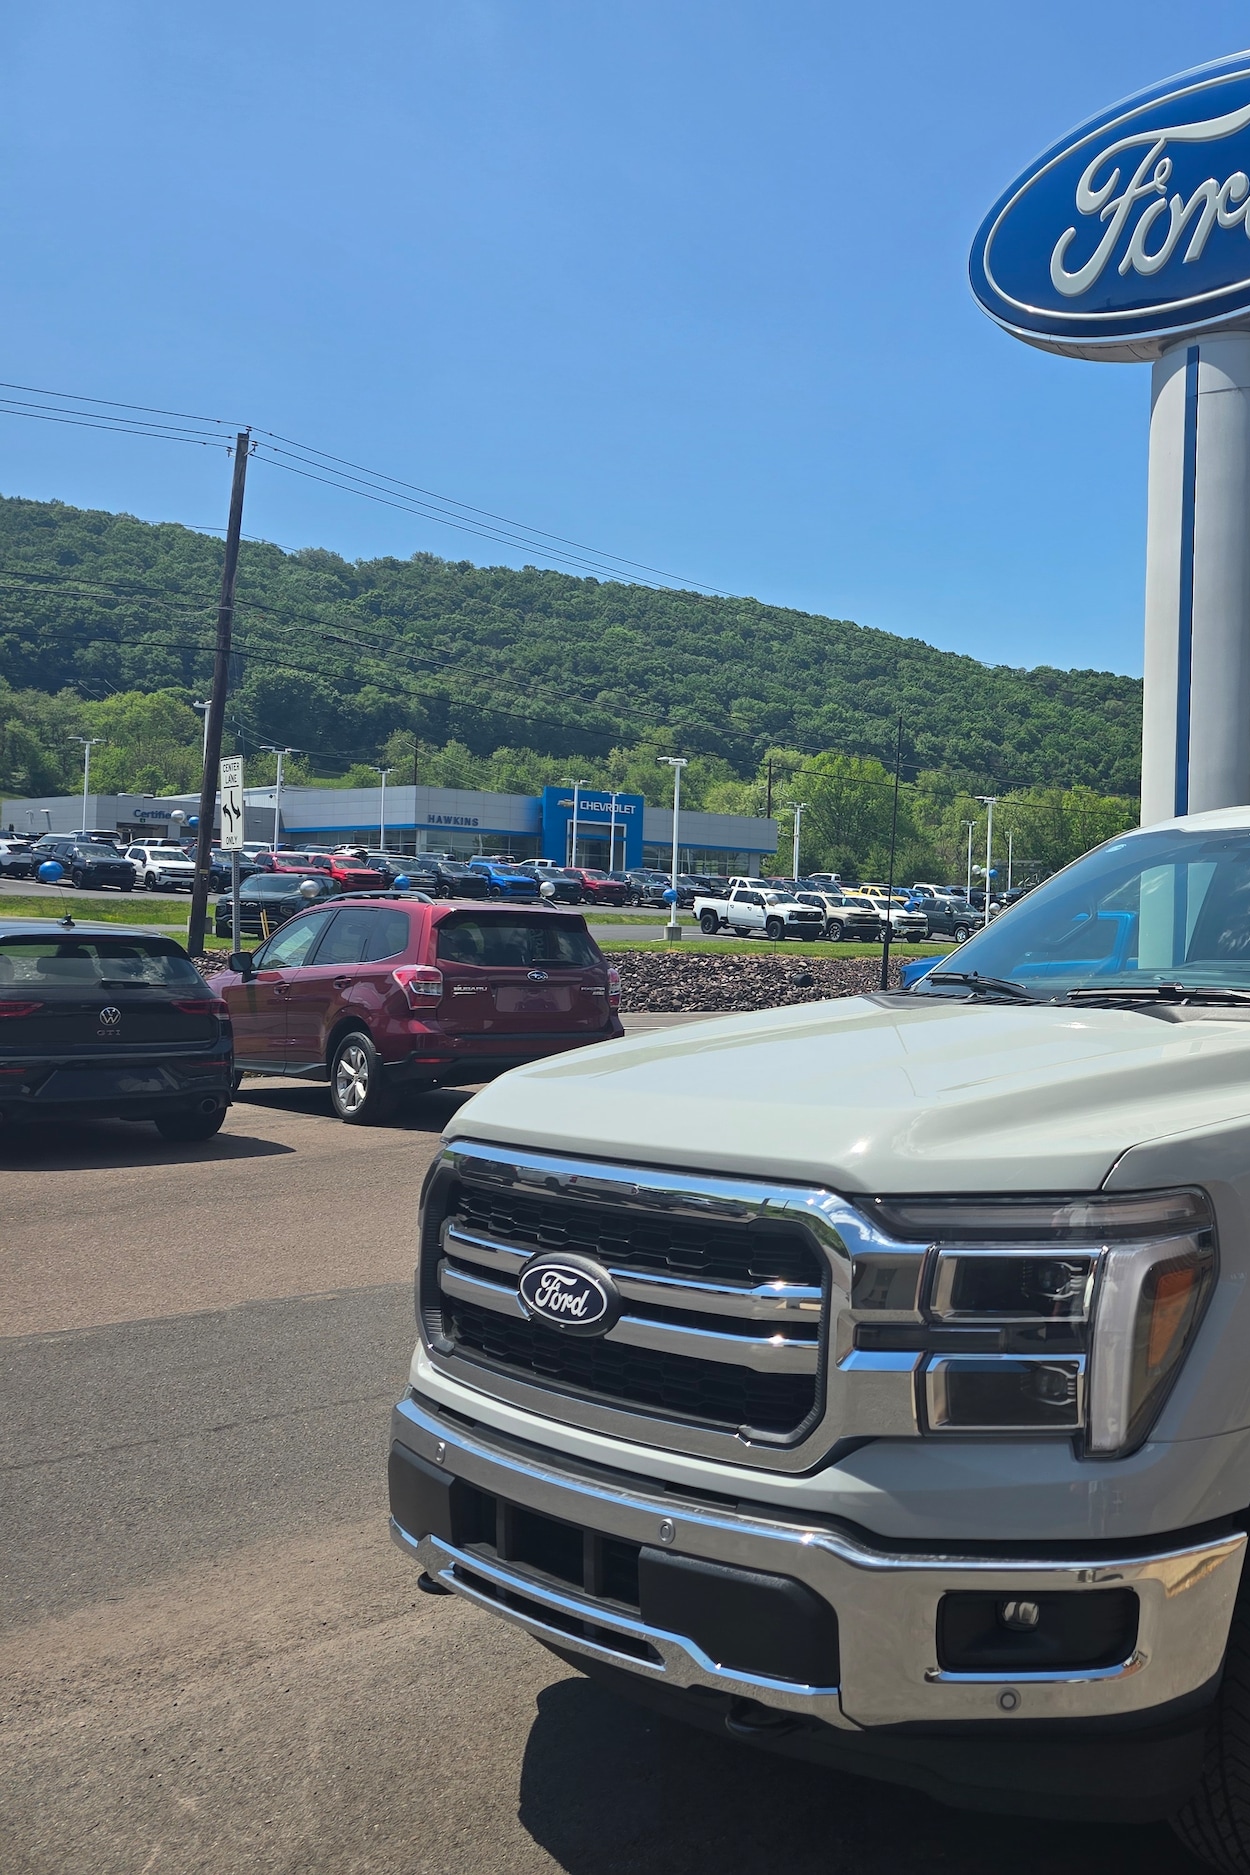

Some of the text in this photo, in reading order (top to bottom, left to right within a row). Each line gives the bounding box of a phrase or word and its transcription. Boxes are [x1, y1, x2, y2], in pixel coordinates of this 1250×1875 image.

[223, 762, 240, 773] CENTER
[225, 774, 237, 784] LANE
[580, 800, 636, 814] CHEVROLET
[134, 809, 172, 819] Certifie
[427, 814, 479, 827] HAWKINS
[226, 835, 238, 845] ONLY
[535, 1271, 591, 1317] Ford
